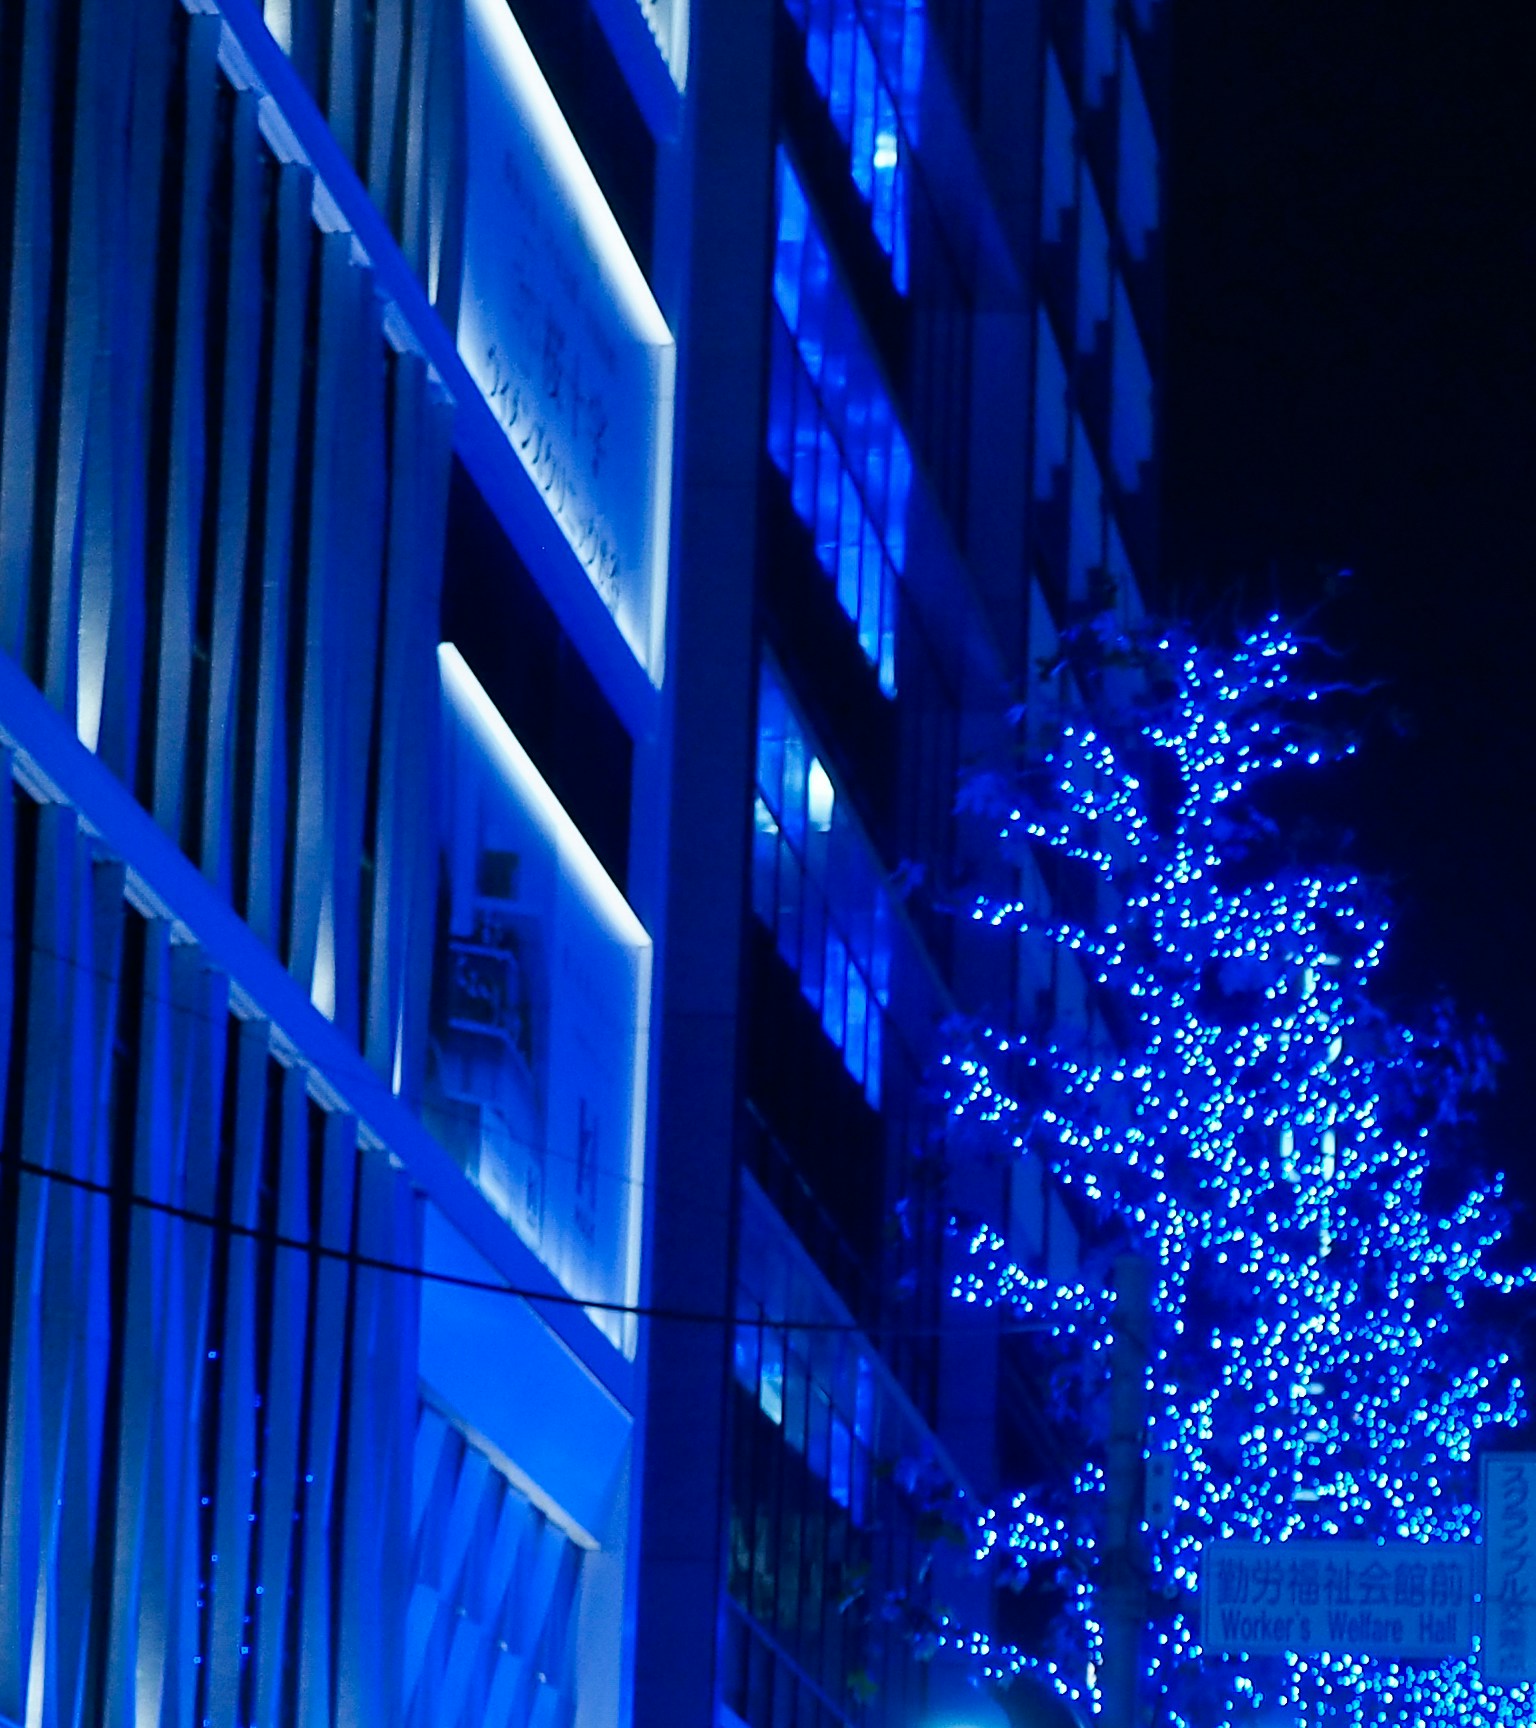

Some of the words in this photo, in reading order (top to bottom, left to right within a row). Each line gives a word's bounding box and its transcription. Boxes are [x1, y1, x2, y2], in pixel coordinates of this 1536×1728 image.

[1216, 1559, 1464, 1607] 勤労福祉会館前
[1220, 1608, 1312, 1642] Worker's
[1327, 1608, 1405, 1643] Welfare
[1418, 1610, 1458, 1643] Hall
